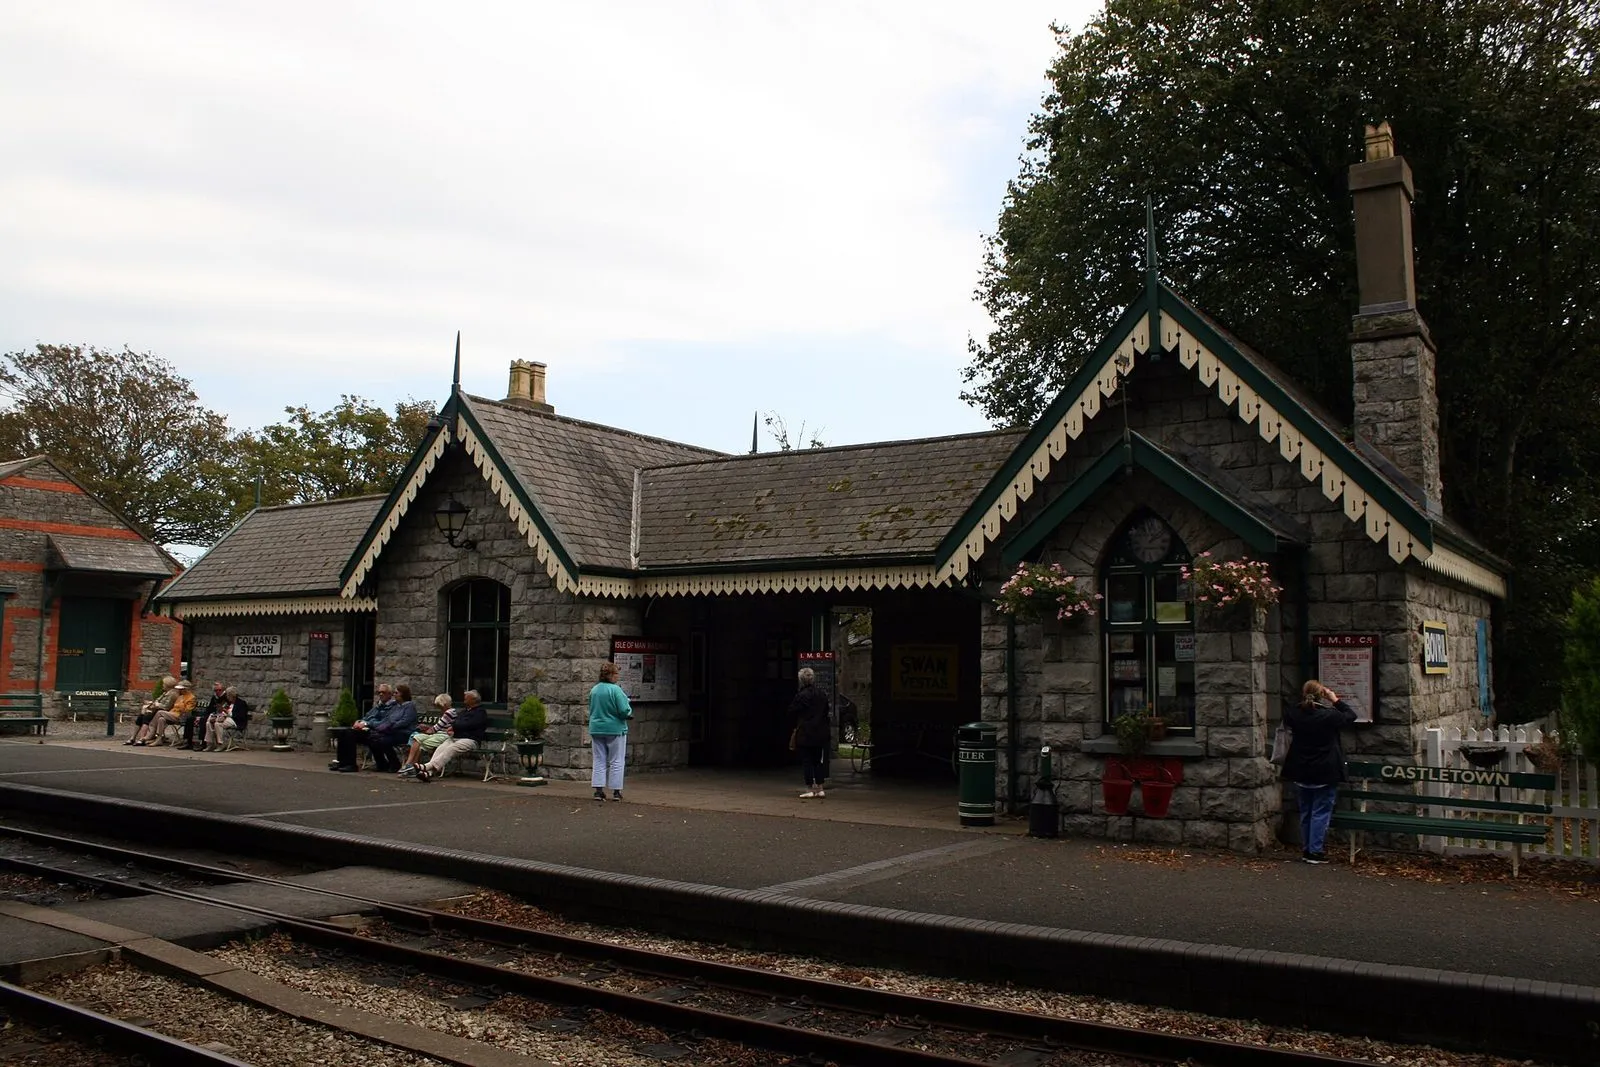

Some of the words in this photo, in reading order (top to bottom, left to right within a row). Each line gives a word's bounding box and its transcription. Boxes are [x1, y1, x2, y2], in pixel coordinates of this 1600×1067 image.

[237, 635, 278, 646] COLMANS
[615, 641, 627, 649] ISLE
[627, 641, 635, 649] OF
[635, 641, 646, 649] MAN
[1425, 631, 1448, 663] BOVRIL
[240, 645, 274, 655] STARCH
[901, 656, 948, 674] SWAN
[1381, 765, 1509, 786] CASTLETOWN
